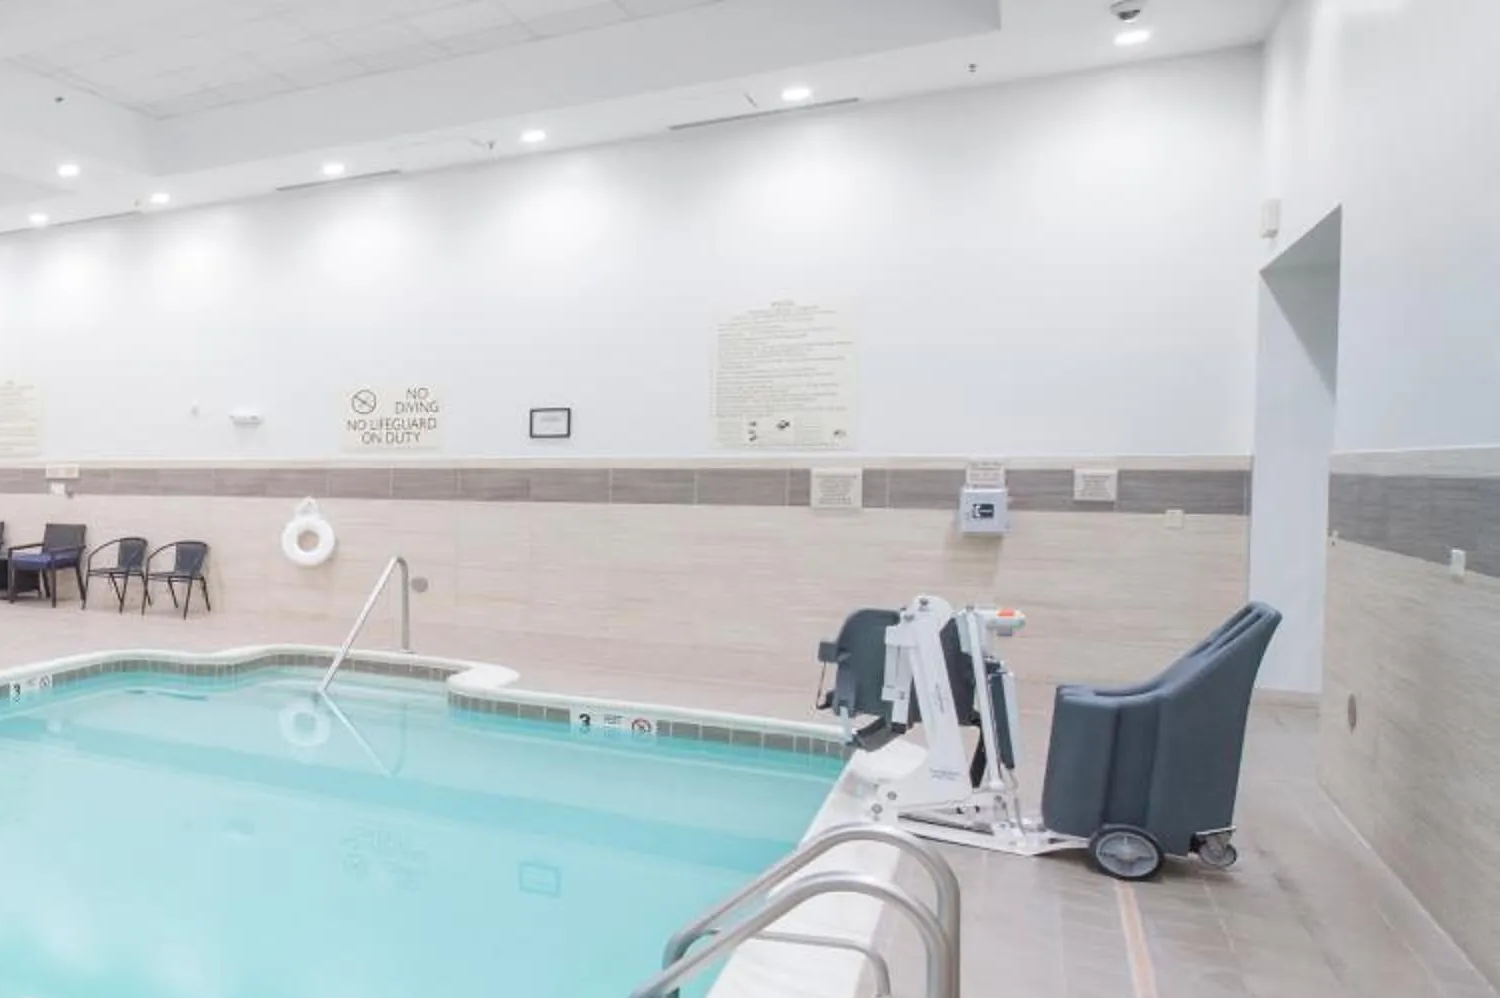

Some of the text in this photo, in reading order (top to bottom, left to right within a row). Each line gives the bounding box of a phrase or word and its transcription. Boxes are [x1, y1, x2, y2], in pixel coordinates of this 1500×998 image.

[405, 386, 430, 401] NO
[394, 400, 439, 414] DIVING
[347, 416, 437, 431] NO LIFEGUARD
[361, 431, 421, 444] ON DUTY
